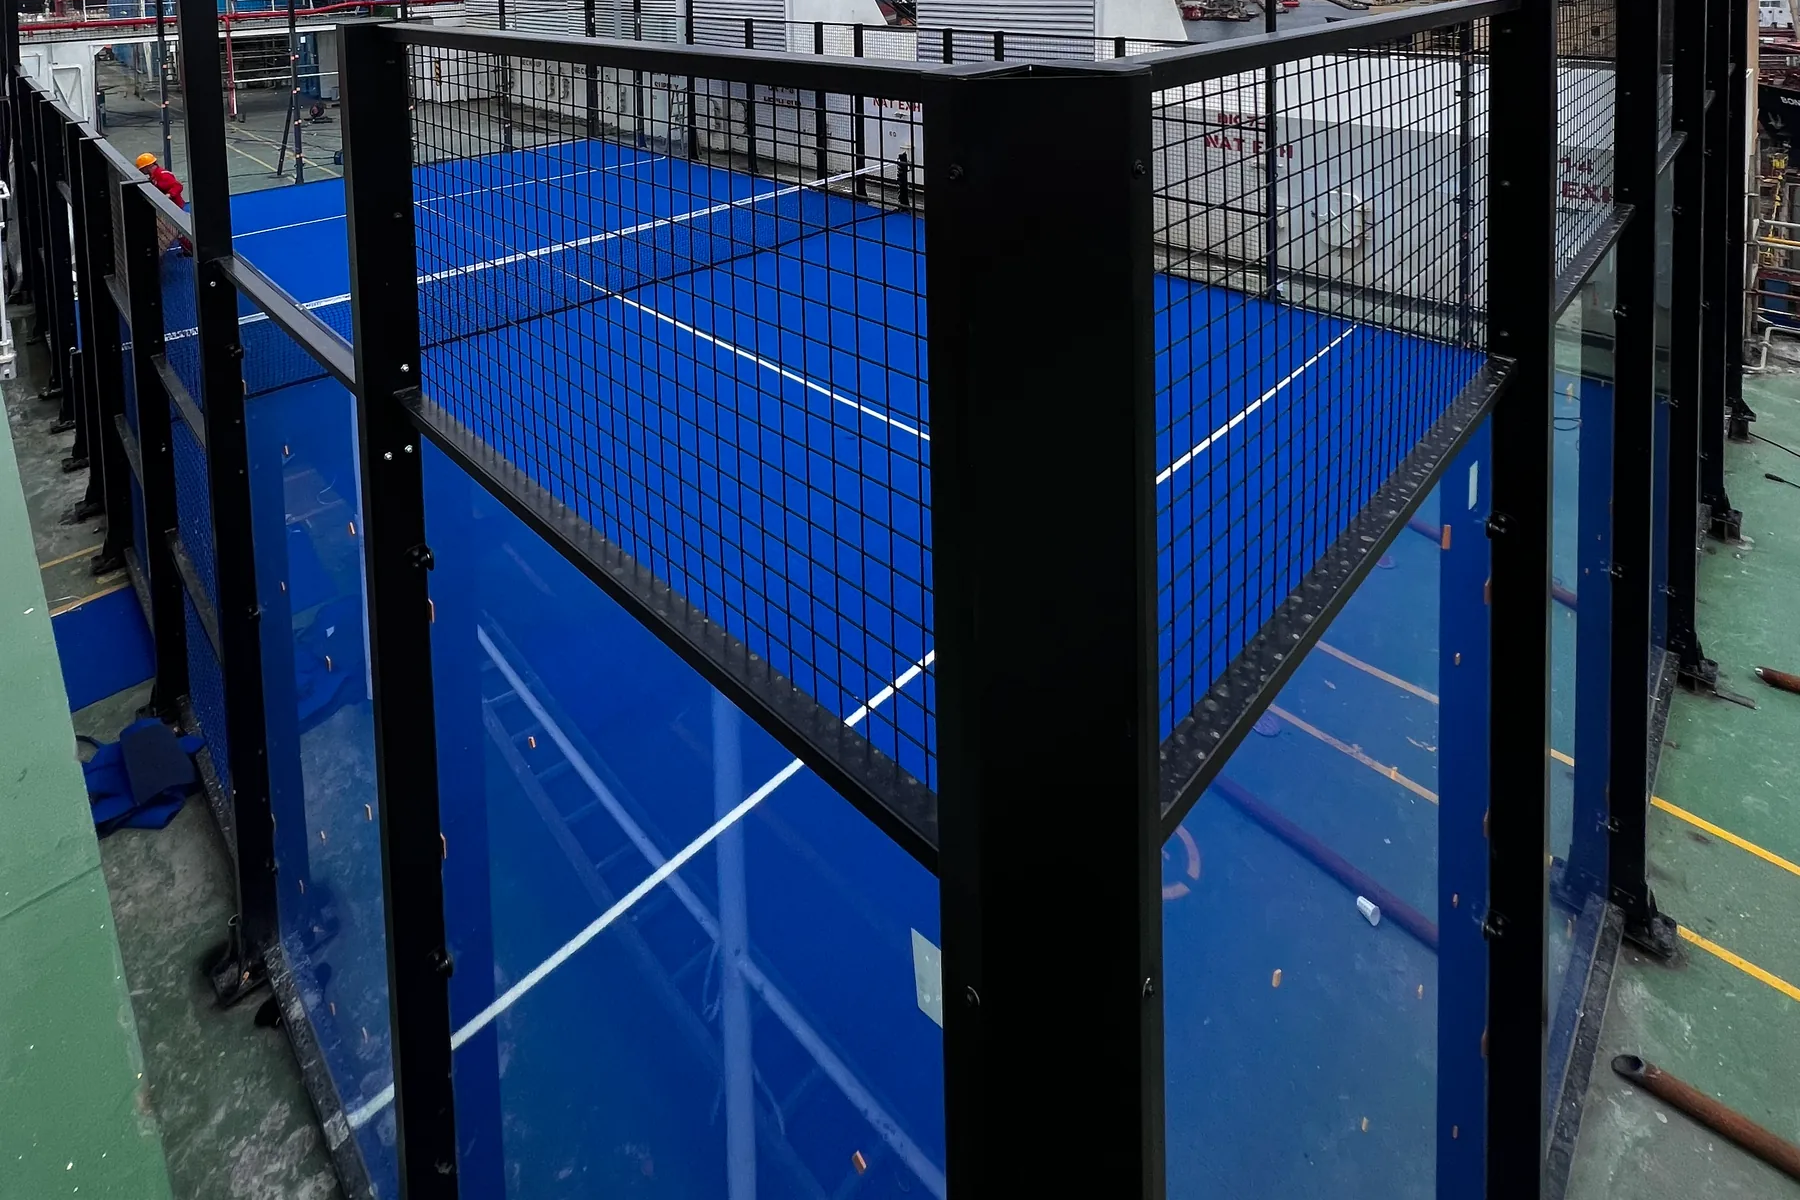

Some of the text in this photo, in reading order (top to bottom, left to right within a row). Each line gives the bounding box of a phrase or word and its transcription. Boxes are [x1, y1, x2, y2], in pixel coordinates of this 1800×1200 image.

[873, 97, 892, 109] NAT
[1204, 134, 1293, 159] NAT EH
